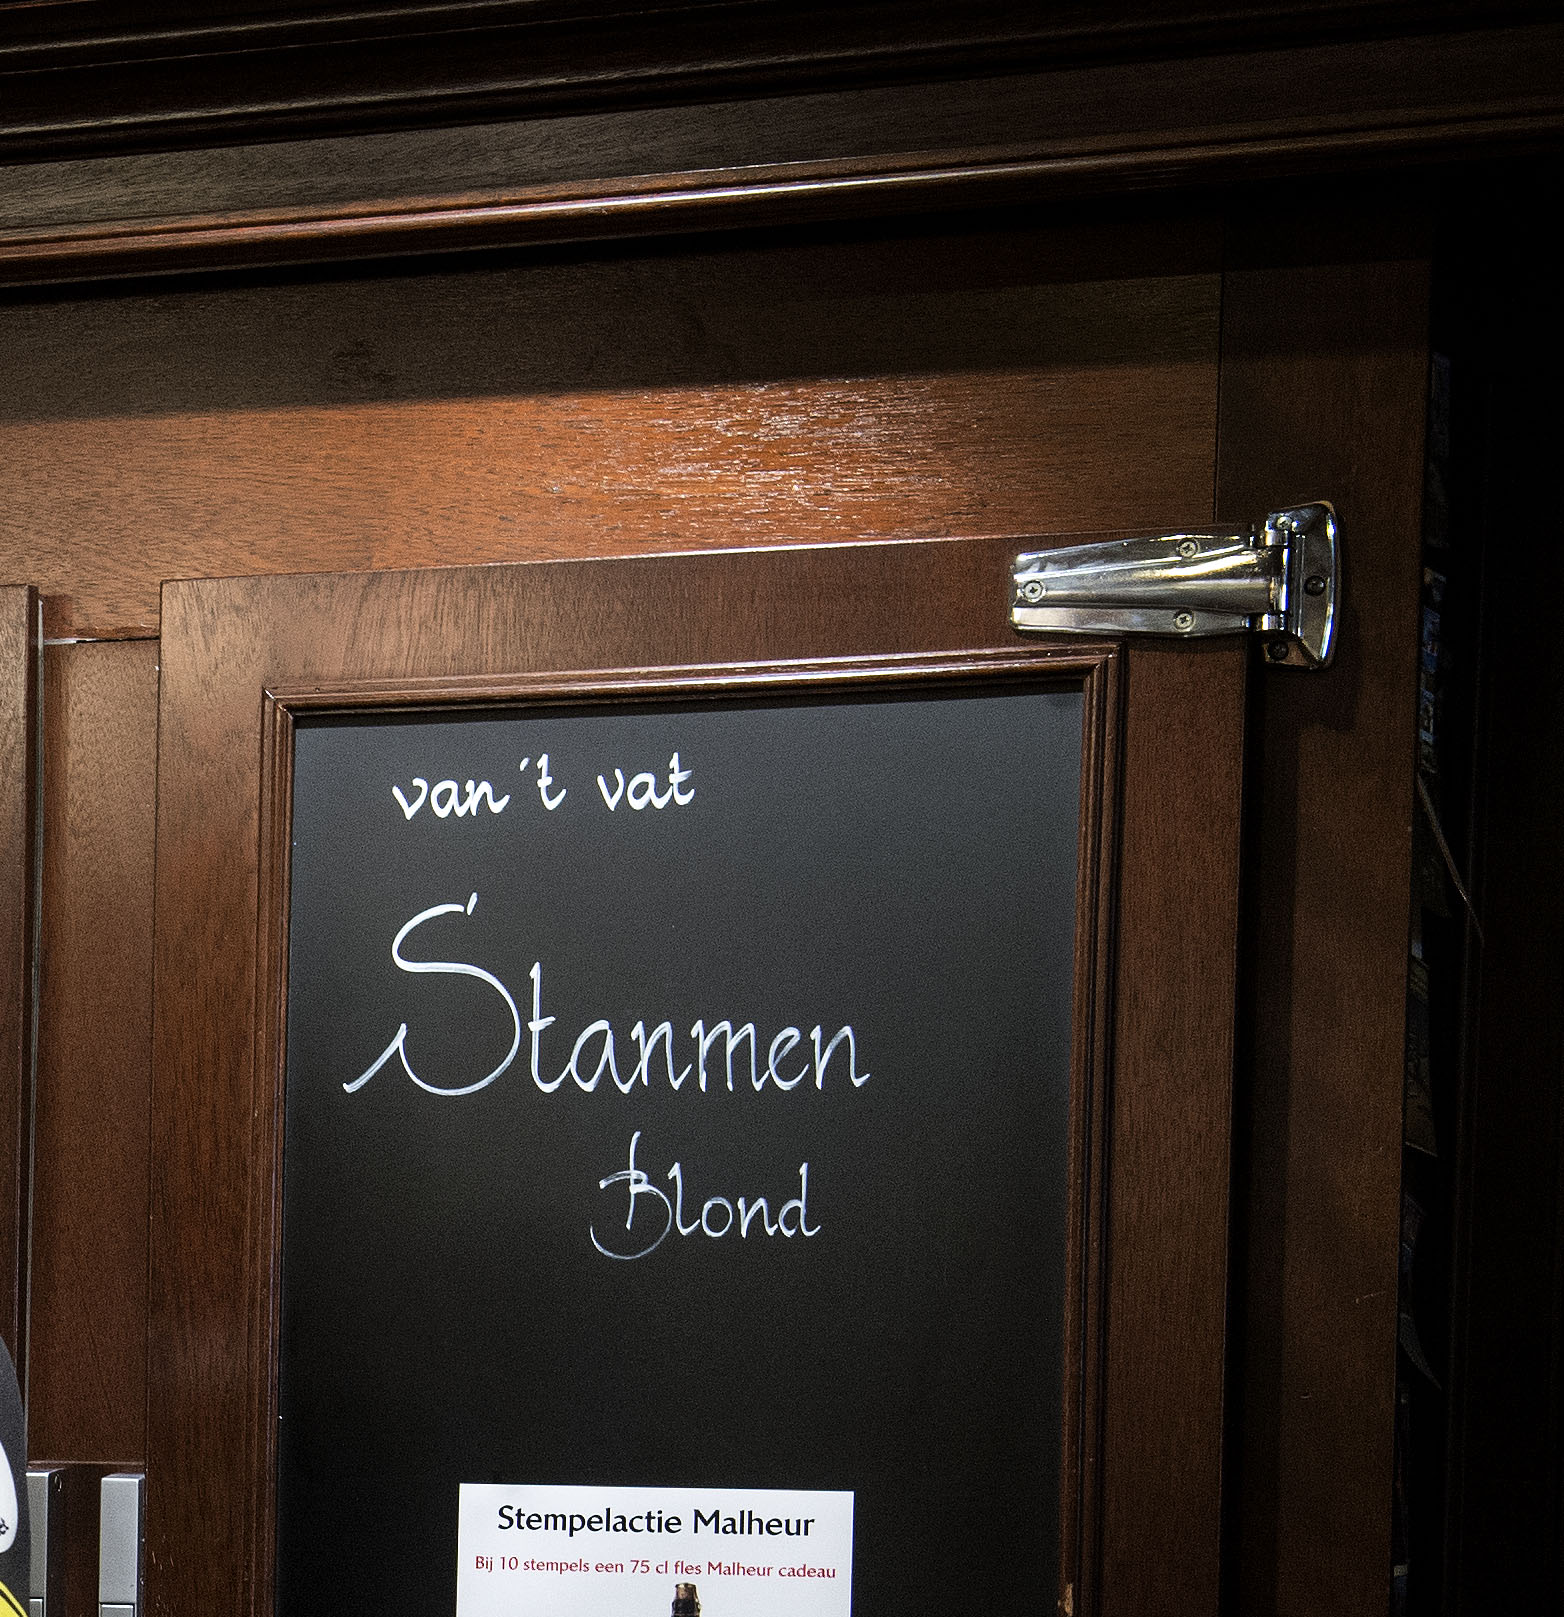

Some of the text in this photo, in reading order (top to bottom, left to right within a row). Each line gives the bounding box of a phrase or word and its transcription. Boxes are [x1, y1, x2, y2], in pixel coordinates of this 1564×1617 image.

[596, 751, 696, 812] vat
[342, 892, 871, 1097] Stanmen
[590, 1131, 821, 1260] Blond
[497, 1504, 815, 1538] Stempelactie Malheur
[474, 1555, 837, 1579] Bij 10 stempels een 75 cl fles Malheur cadeau
